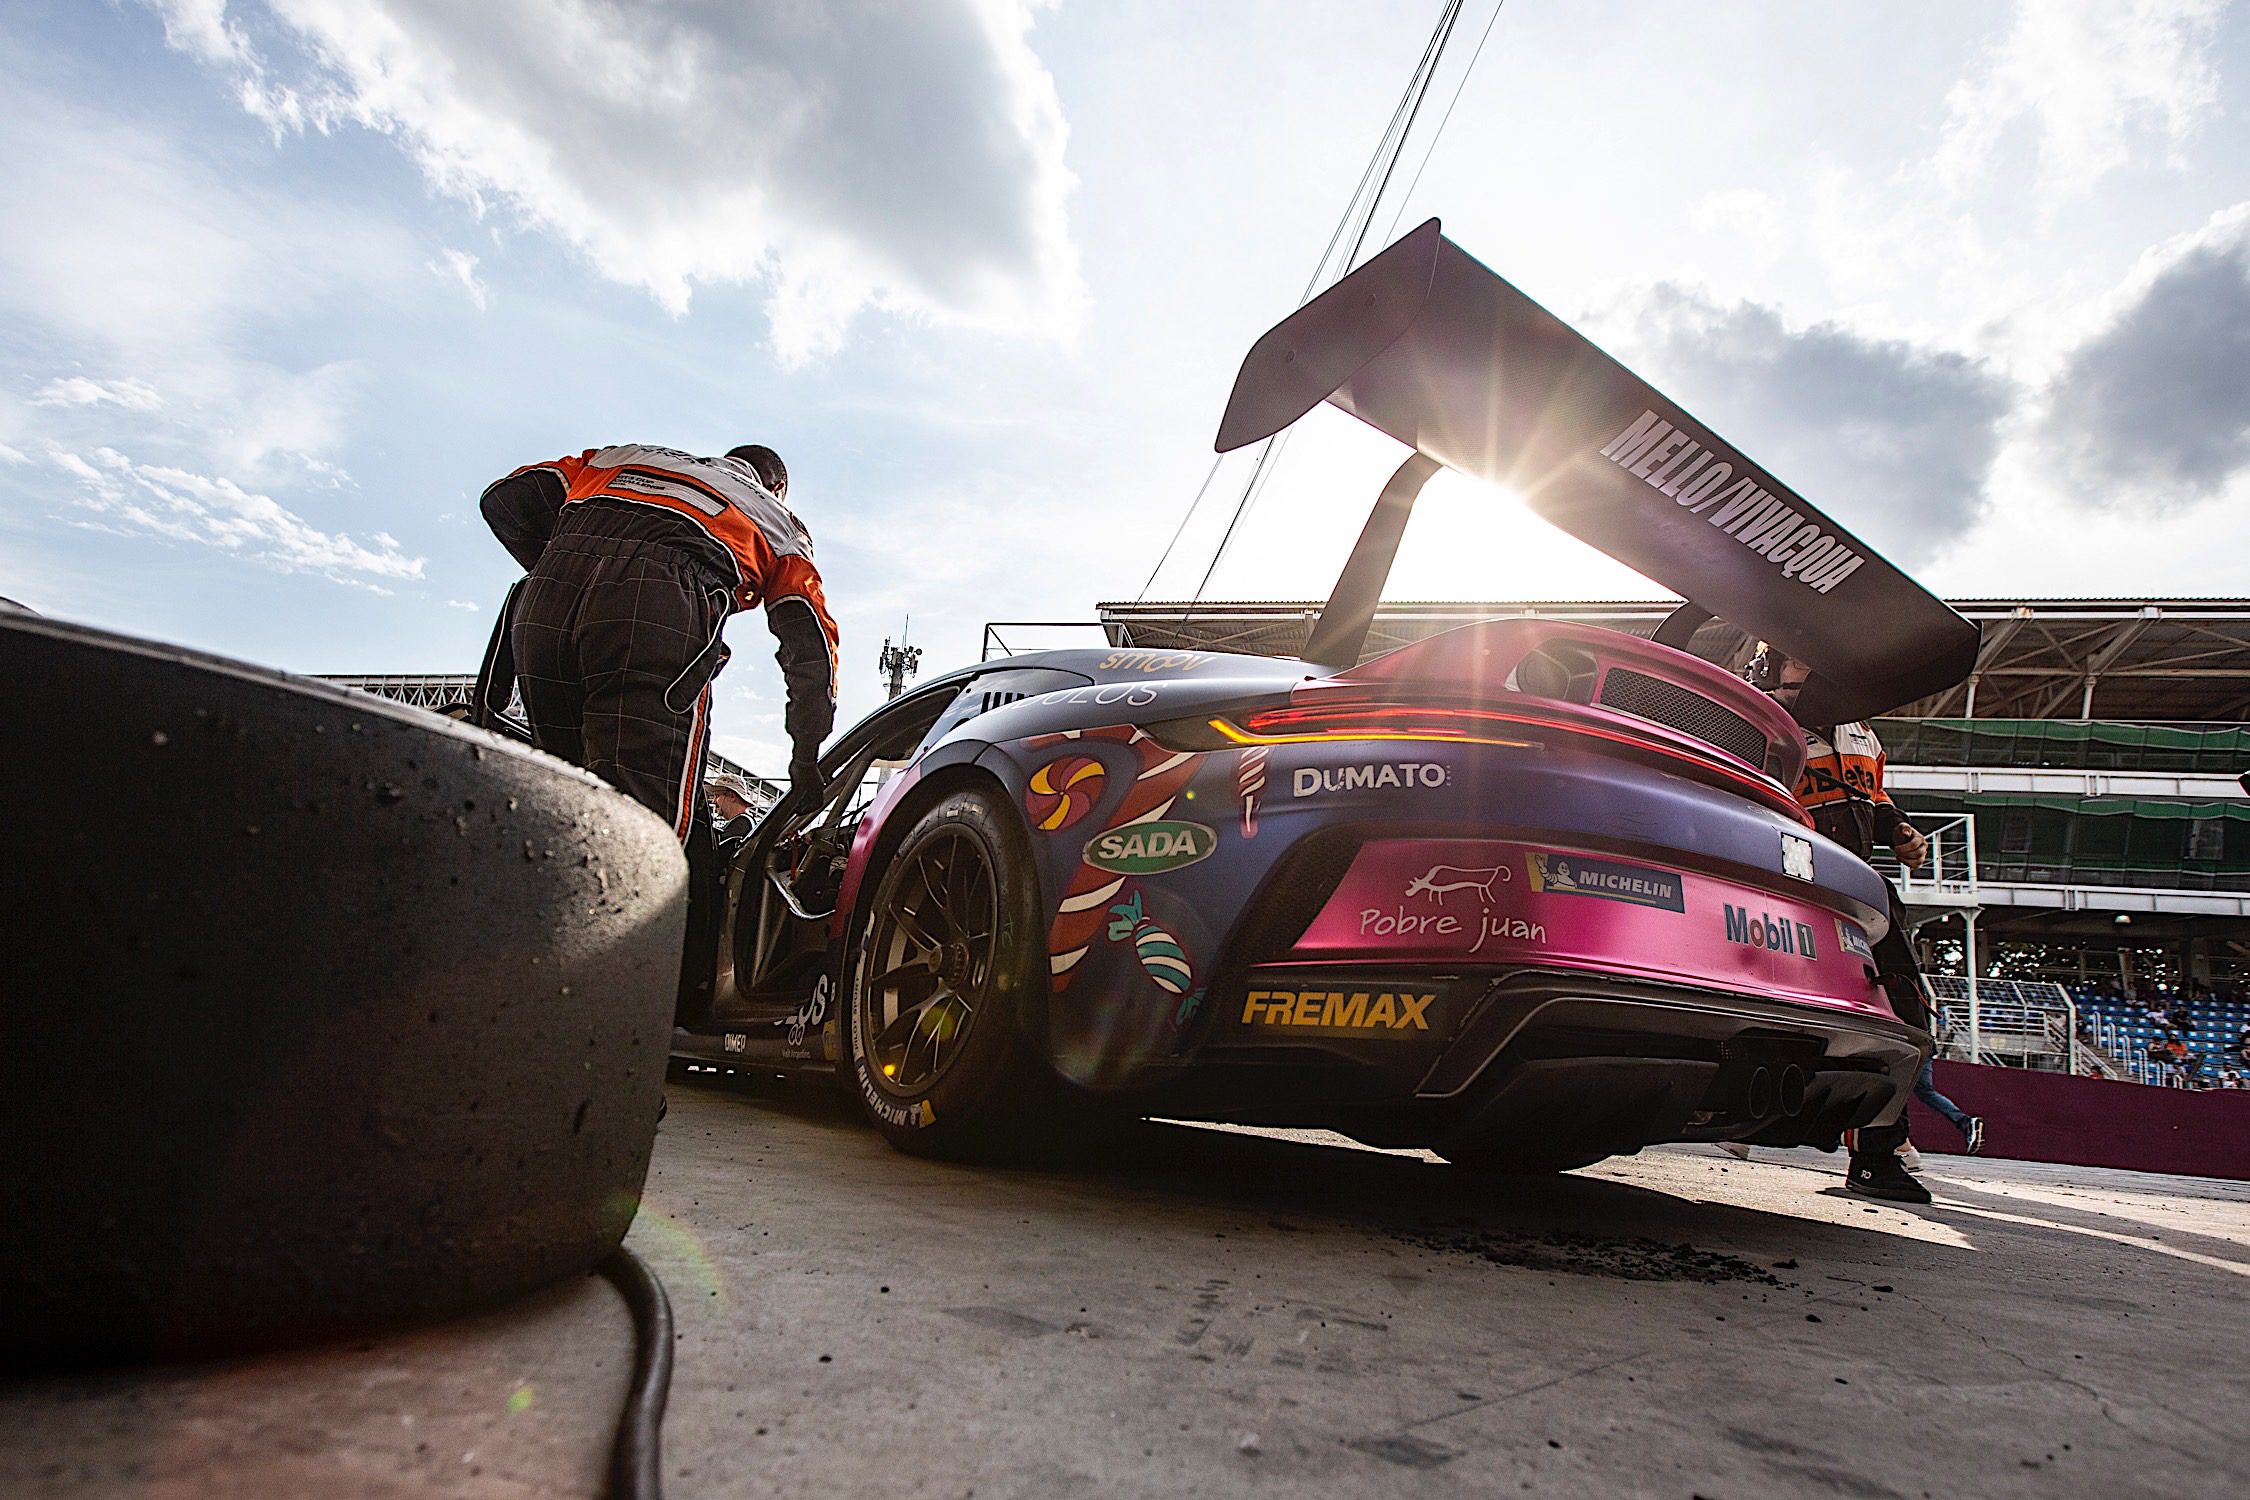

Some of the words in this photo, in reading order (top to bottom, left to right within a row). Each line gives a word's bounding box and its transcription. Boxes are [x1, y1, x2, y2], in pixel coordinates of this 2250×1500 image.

[1293, 762, 1447, 798] DUMATO
[1097, 829, 1198, 860] SADA
[1578, 870, 1673, 899] MICHELIN
[1359, 905, 1463, 936] Pobre
[1467, 906, 1547, 954] juan
[1723, 902, 1796, 955] Mobil
[1241, 990, 1438, 1030] FREMAX
[856, 1064, 908, 1127] MICHELIN
